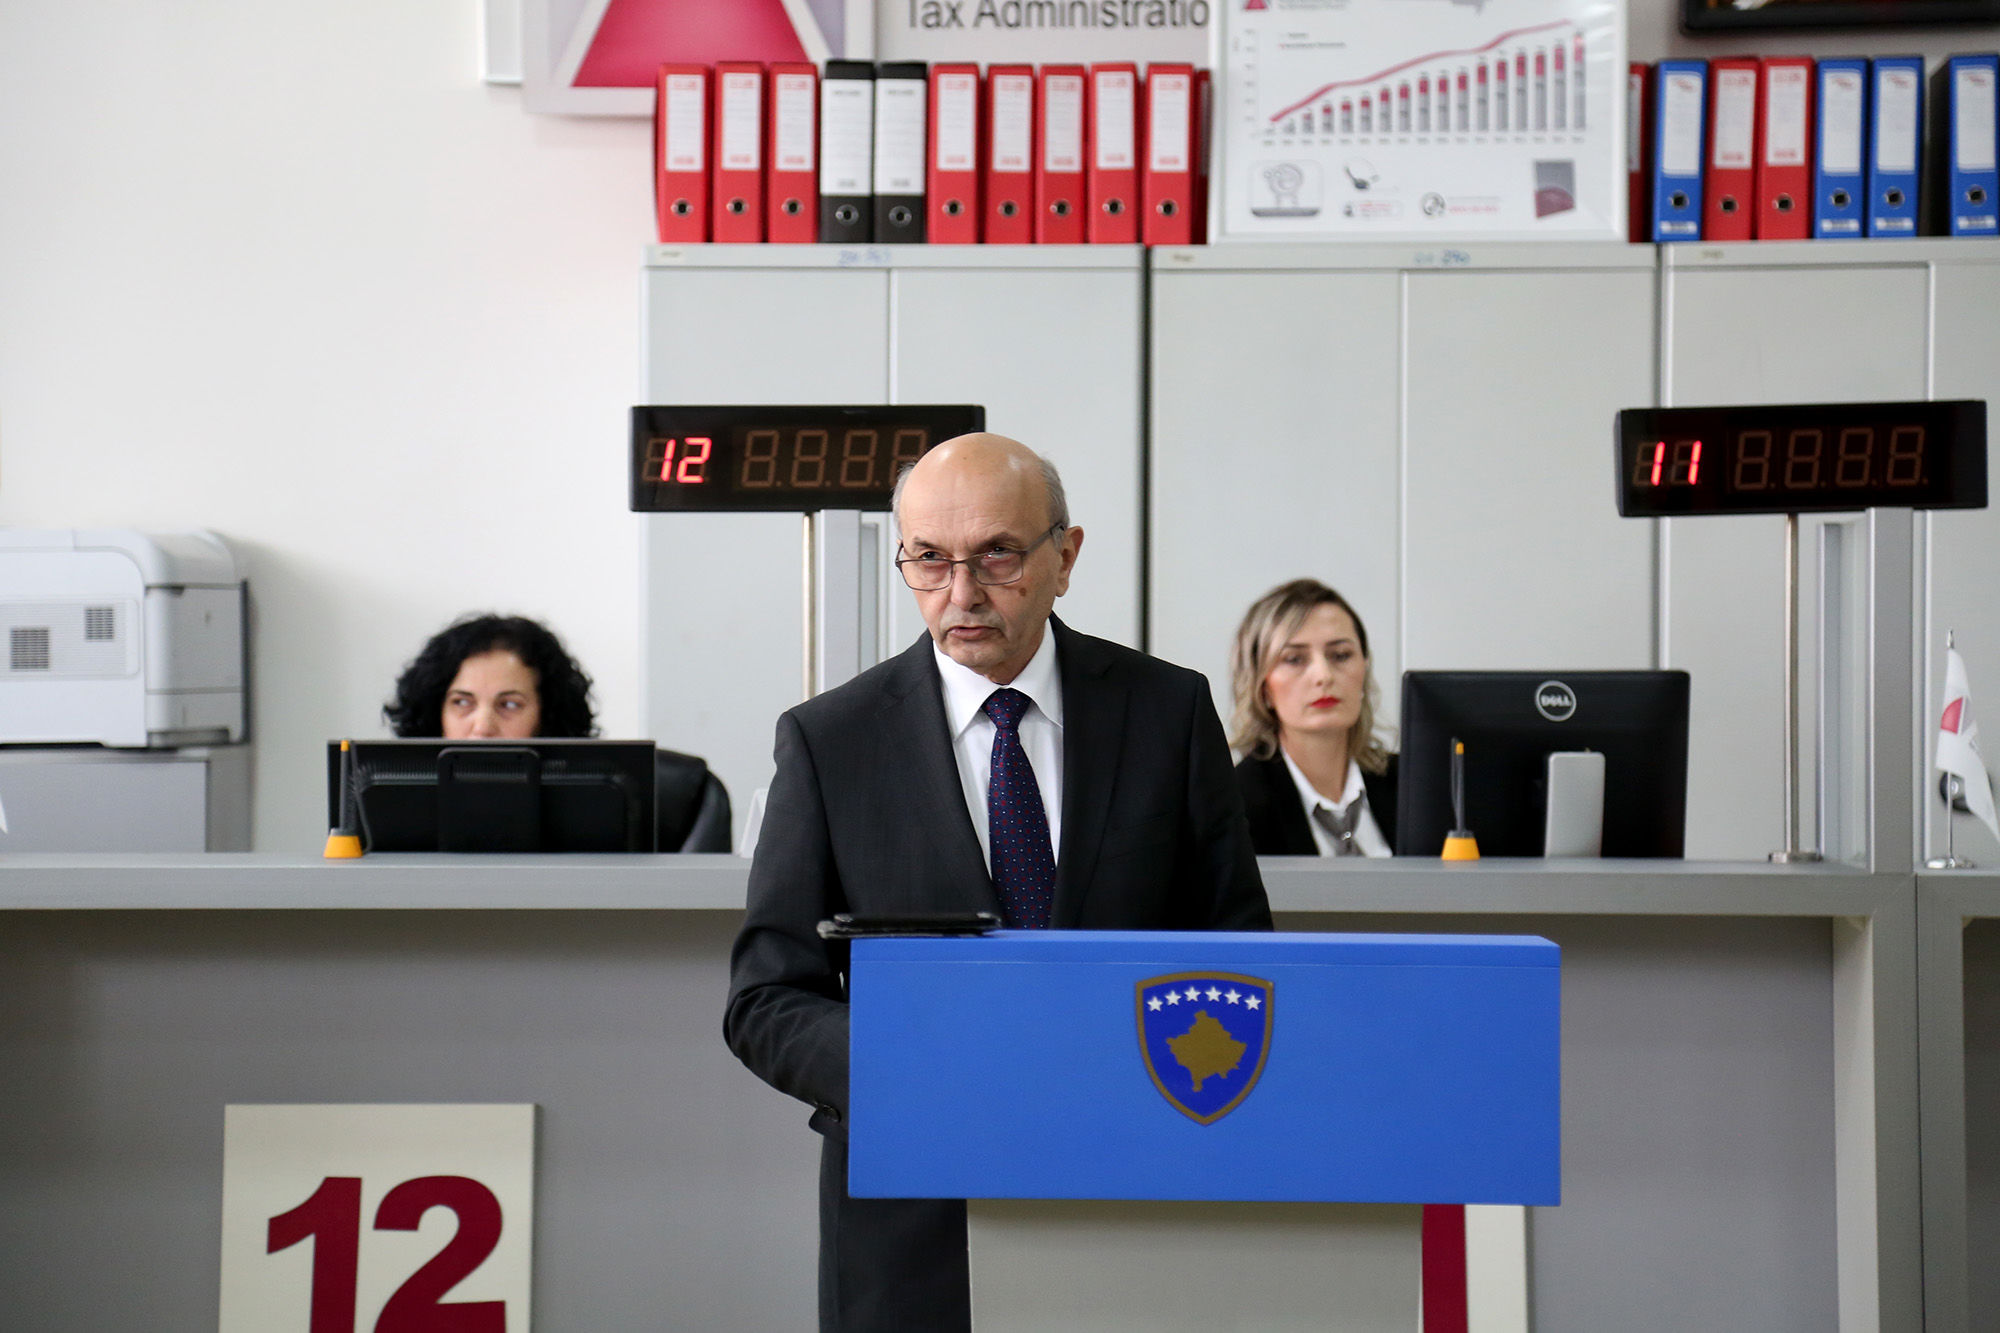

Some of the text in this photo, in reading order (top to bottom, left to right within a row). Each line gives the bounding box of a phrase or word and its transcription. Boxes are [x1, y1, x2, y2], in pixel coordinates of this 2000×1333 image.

[908, 0, 965, 28] Tax
[660, 436, 712, 484] 12
[1651, 440, 1702, 486] 11
[1540, 694, 1570, 708] DELL
[266, 1175, 506, 1333] 12
